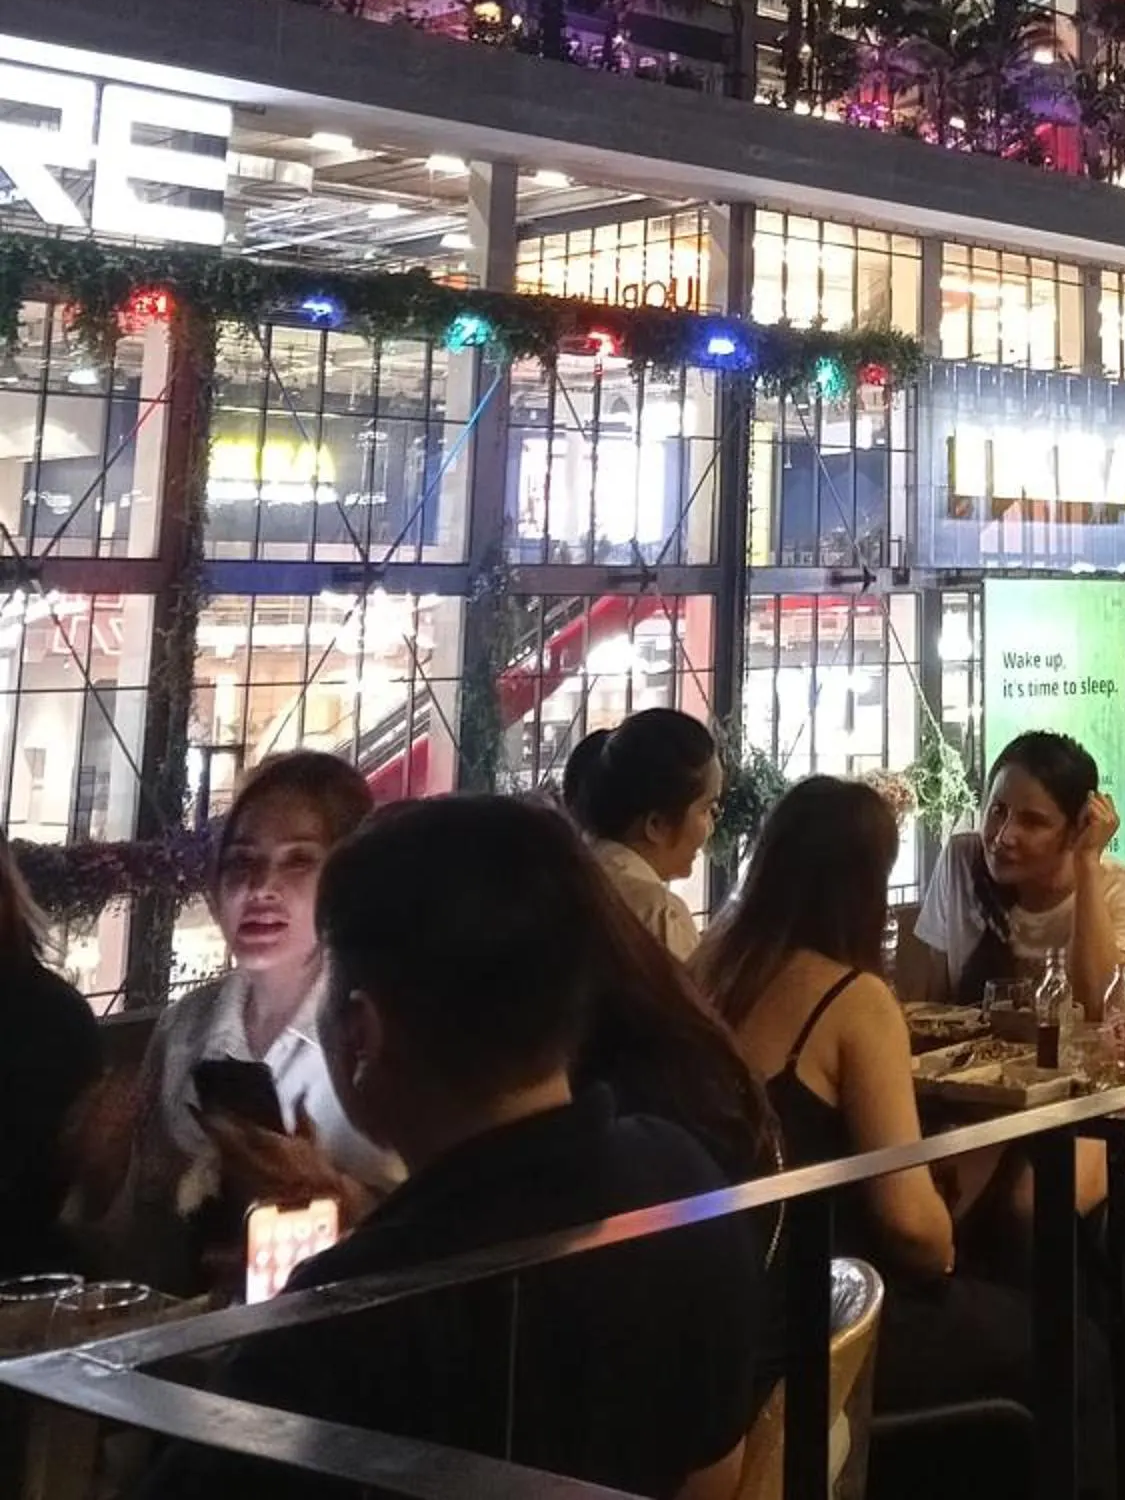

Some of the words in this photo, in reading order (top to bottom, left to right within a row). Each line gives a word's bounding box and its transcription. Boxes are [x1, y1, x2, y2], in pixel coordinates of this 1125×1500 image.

[1002, 651, 1041, 669] Wake
[1003, 678, 1025, 698] it's
[1028, 679, 1059, 697] time
[1063, 680, 1077, 695] to
[1080, 676, 1119, 699] sleep.
